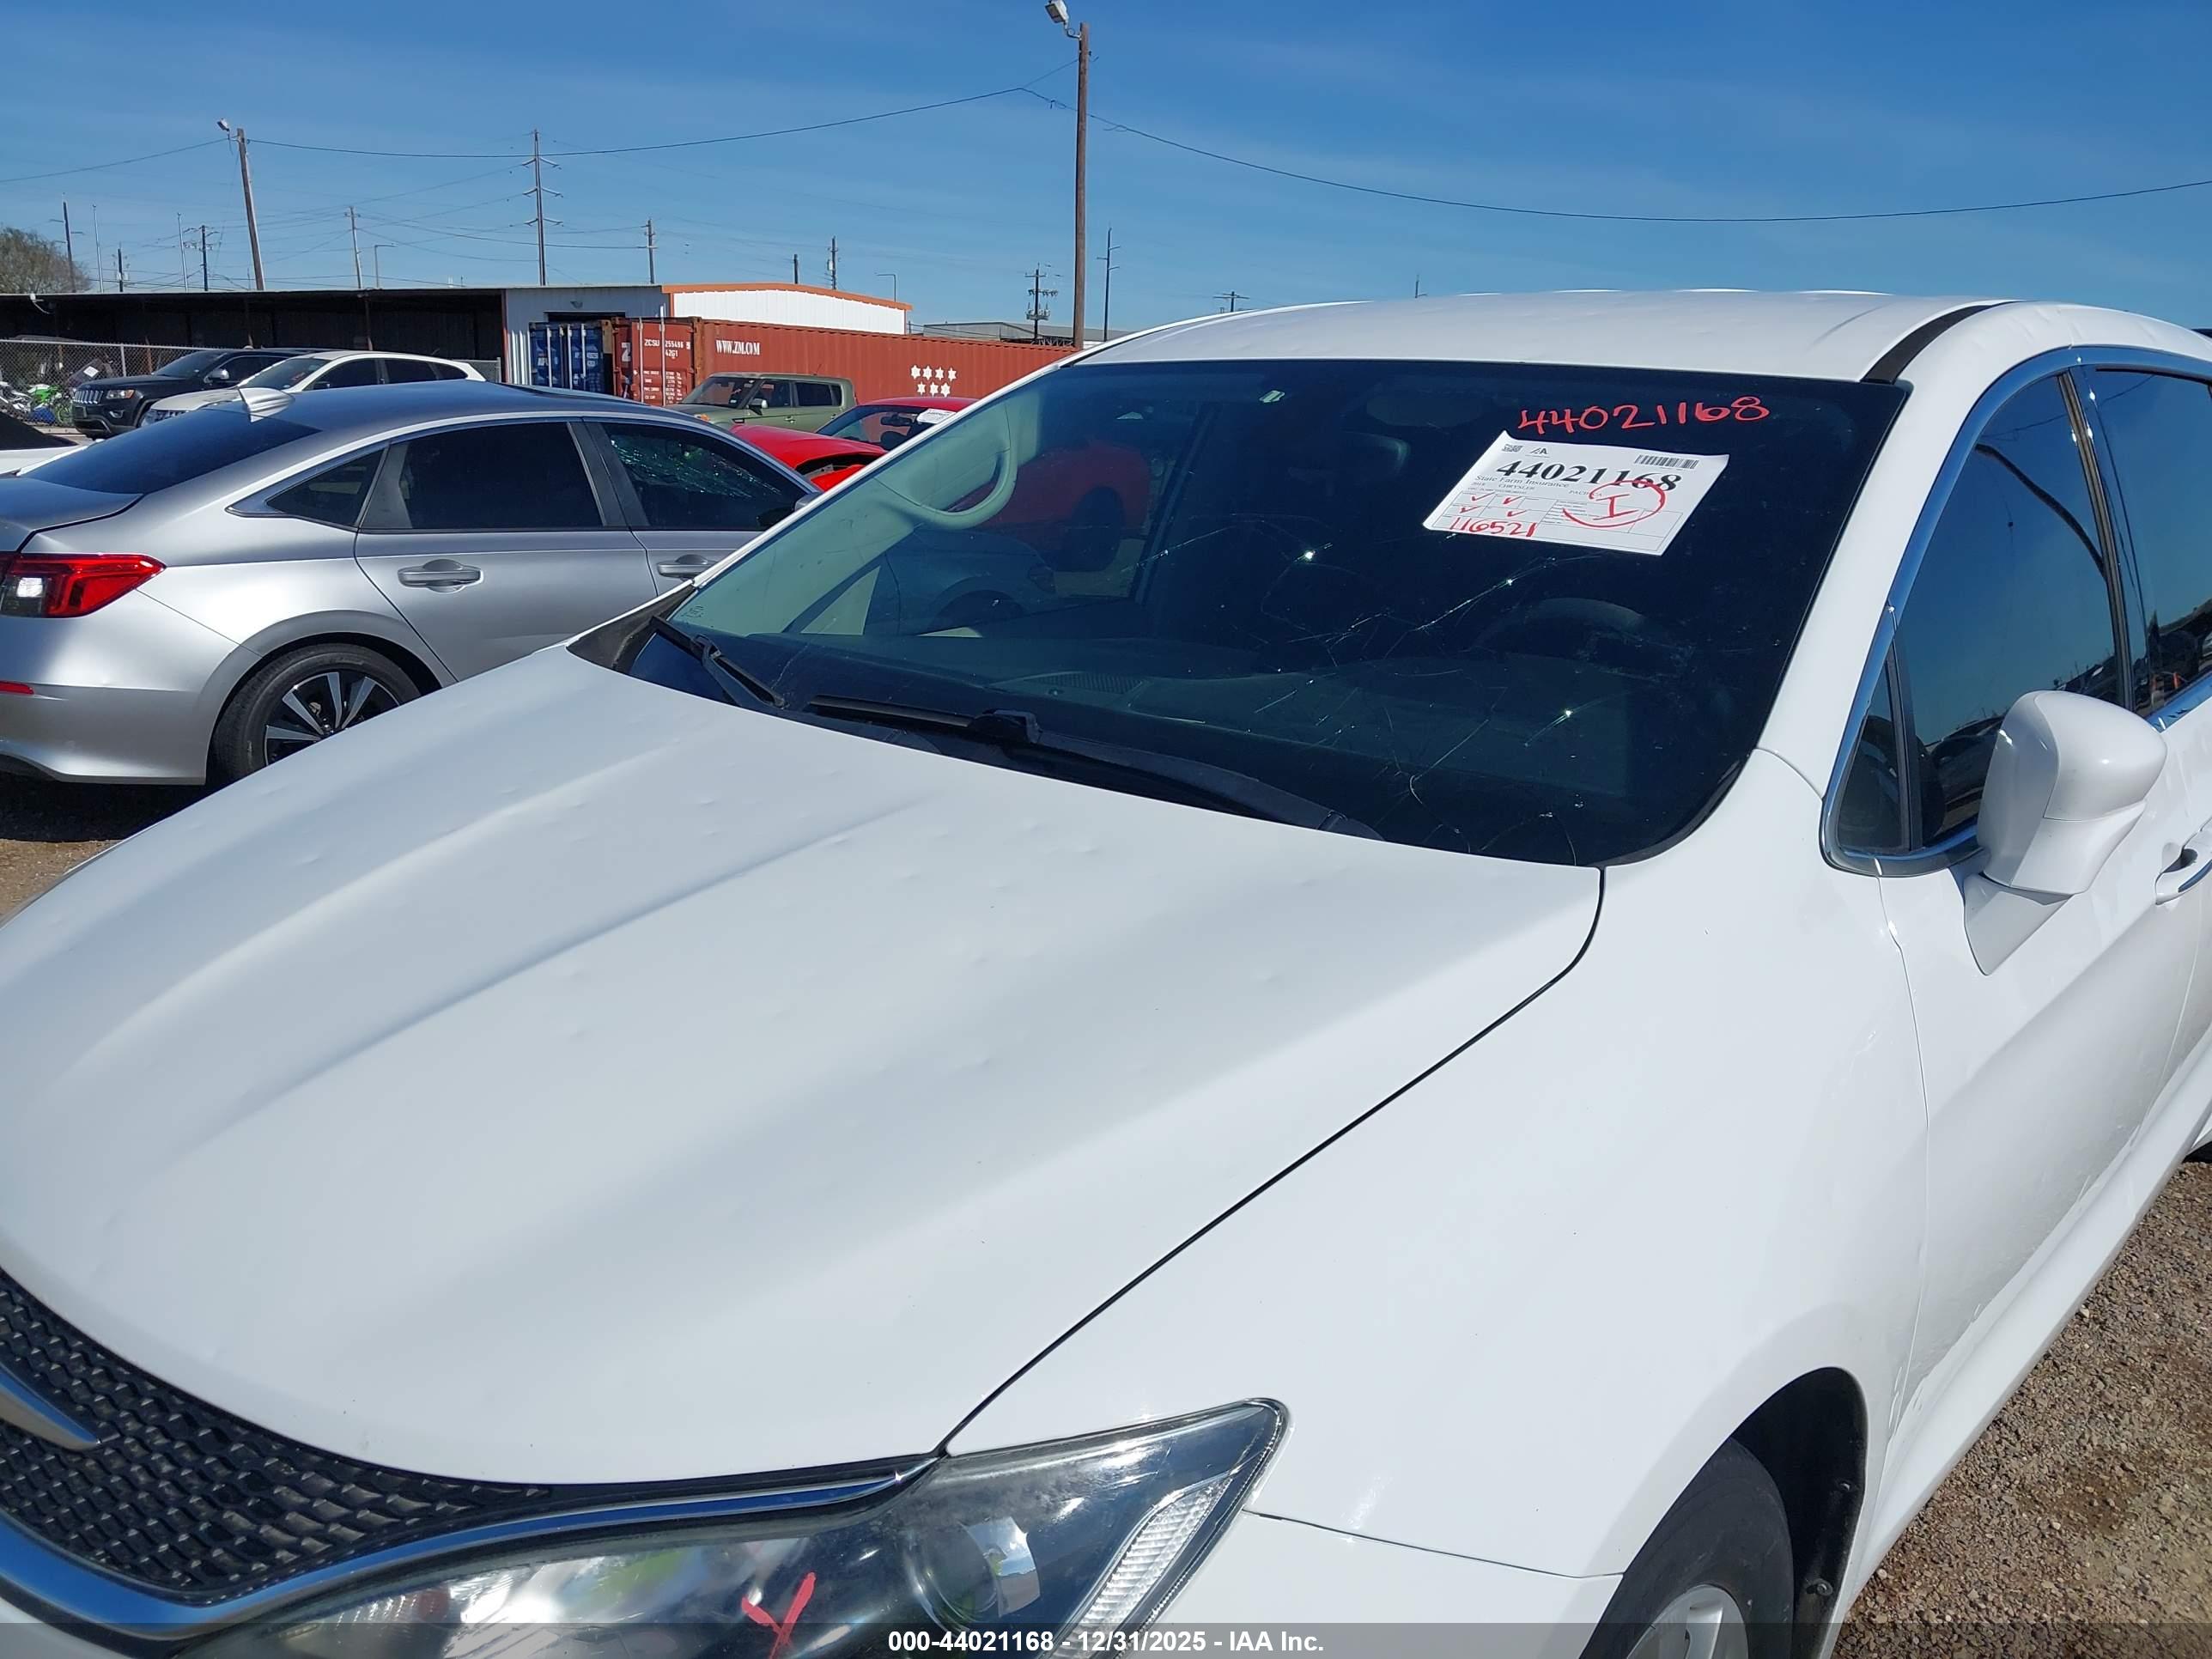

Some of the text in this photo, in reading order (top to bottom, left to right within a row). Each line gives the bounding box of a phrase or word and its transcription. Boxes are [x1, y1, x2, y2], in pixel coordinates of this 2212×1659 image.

[644, 338, 660, 347] ZCSU
[1518, 396, 1770, 434] 44021168
[1496, 460, 1682, 492] 44021168
[1525, 478, 1570, 488] Insurance
[1449, 517, 1537, 538] 116521
